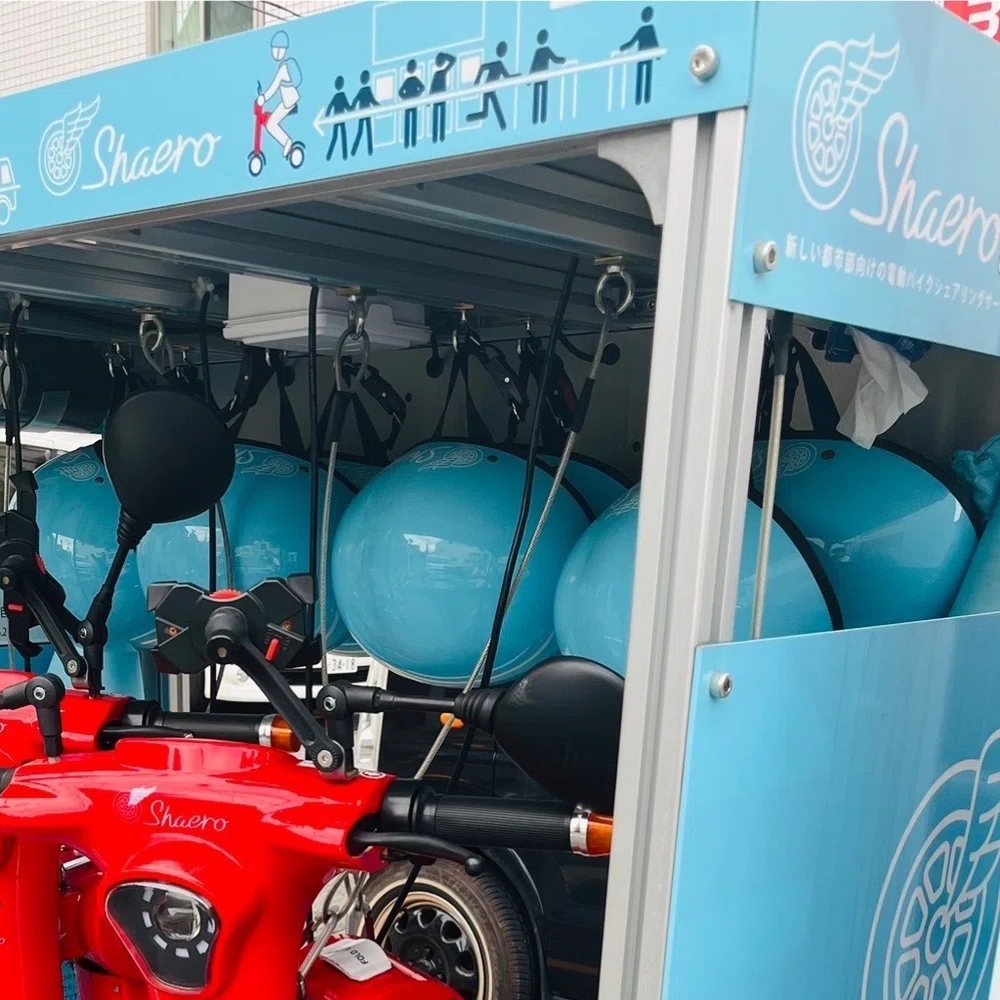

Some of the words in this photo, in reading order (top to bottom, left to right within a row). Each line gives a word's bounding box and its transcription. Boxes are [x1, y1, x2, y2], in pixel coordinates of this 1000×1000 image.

[81, 126, 222, 191] Shaero
[850, 112, 1000, 263] Shaero
[143, 799, 231, 832] Shaero
